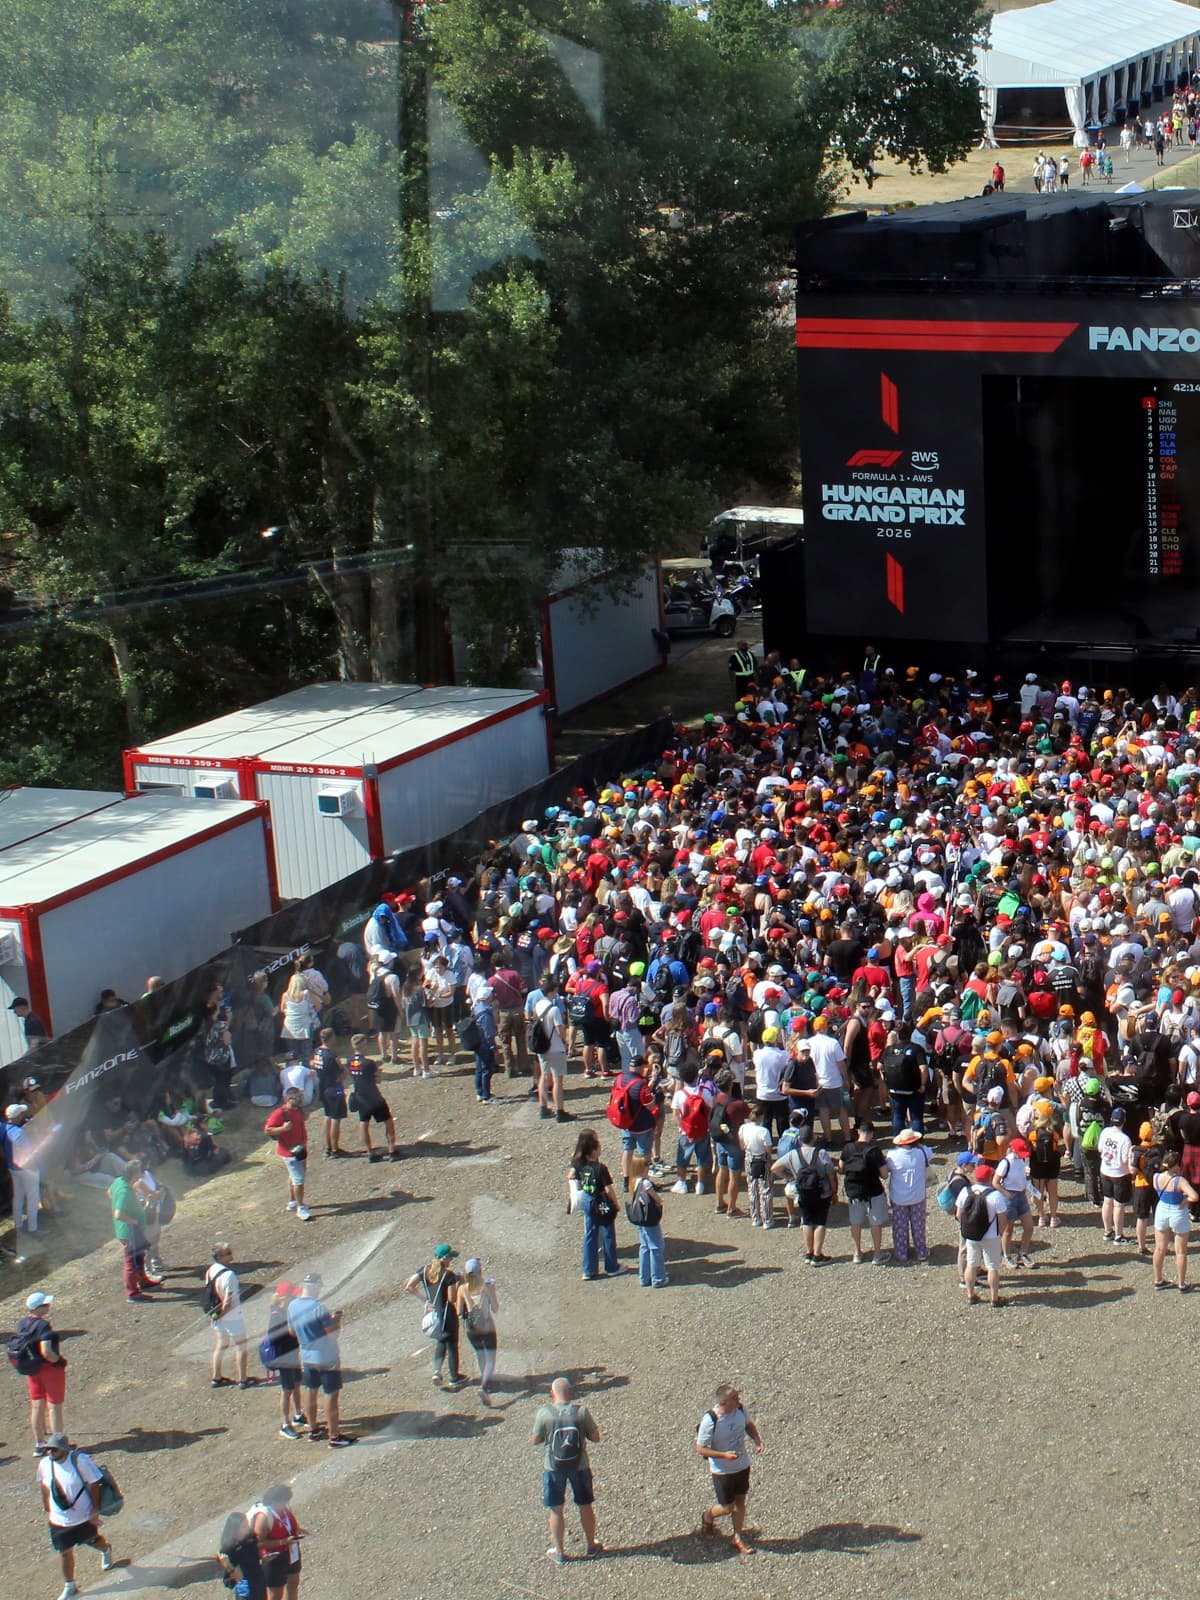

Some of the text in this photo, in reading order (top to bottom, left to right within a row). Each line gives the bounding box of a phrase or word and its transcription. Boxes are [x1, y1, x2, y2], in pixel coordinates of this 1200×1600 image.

[911, 451, 939, 464] aws
[852, 472, 896, 481] FORMULA
[822, 484, 965, 506] HUNGARIAN
[822, 504, 966, 525] GRAND PRIX
[877, 528, 912, 538] 2026
[65, 1048, 138, 1095] FANZONE
